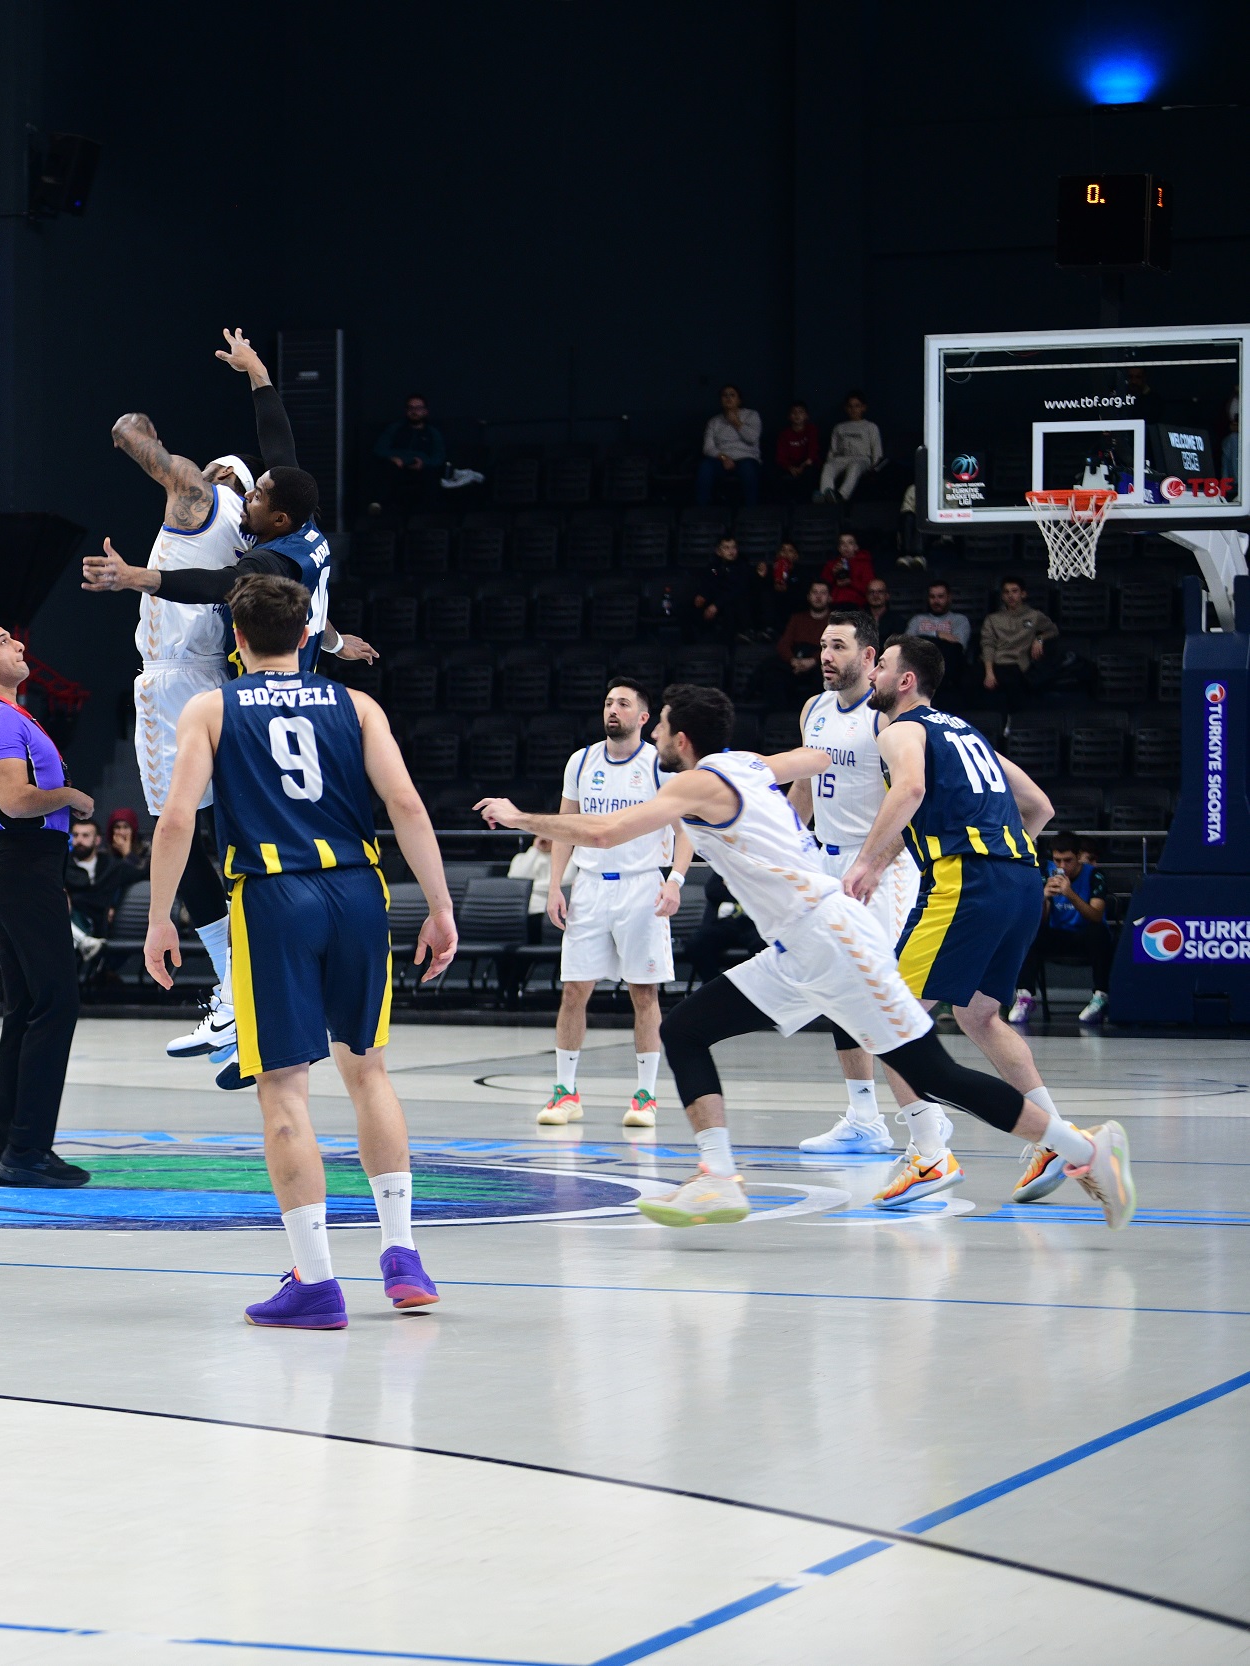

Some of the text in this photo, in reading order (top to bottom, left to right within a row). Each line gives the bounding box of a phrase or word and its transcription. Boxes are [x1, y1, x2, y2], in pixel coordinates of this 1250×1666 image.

[1044, 394, 1136, 409] www.tbf.org.tr
[1187, 478, 1235, 498] TBF
[268, 715, 324, 803] 9
[943, 731, 1006, 794] 10
[1207, 704, 1223, 843] TÜRKİYE SİGORTA
[817, 773, 836, 798] 15
